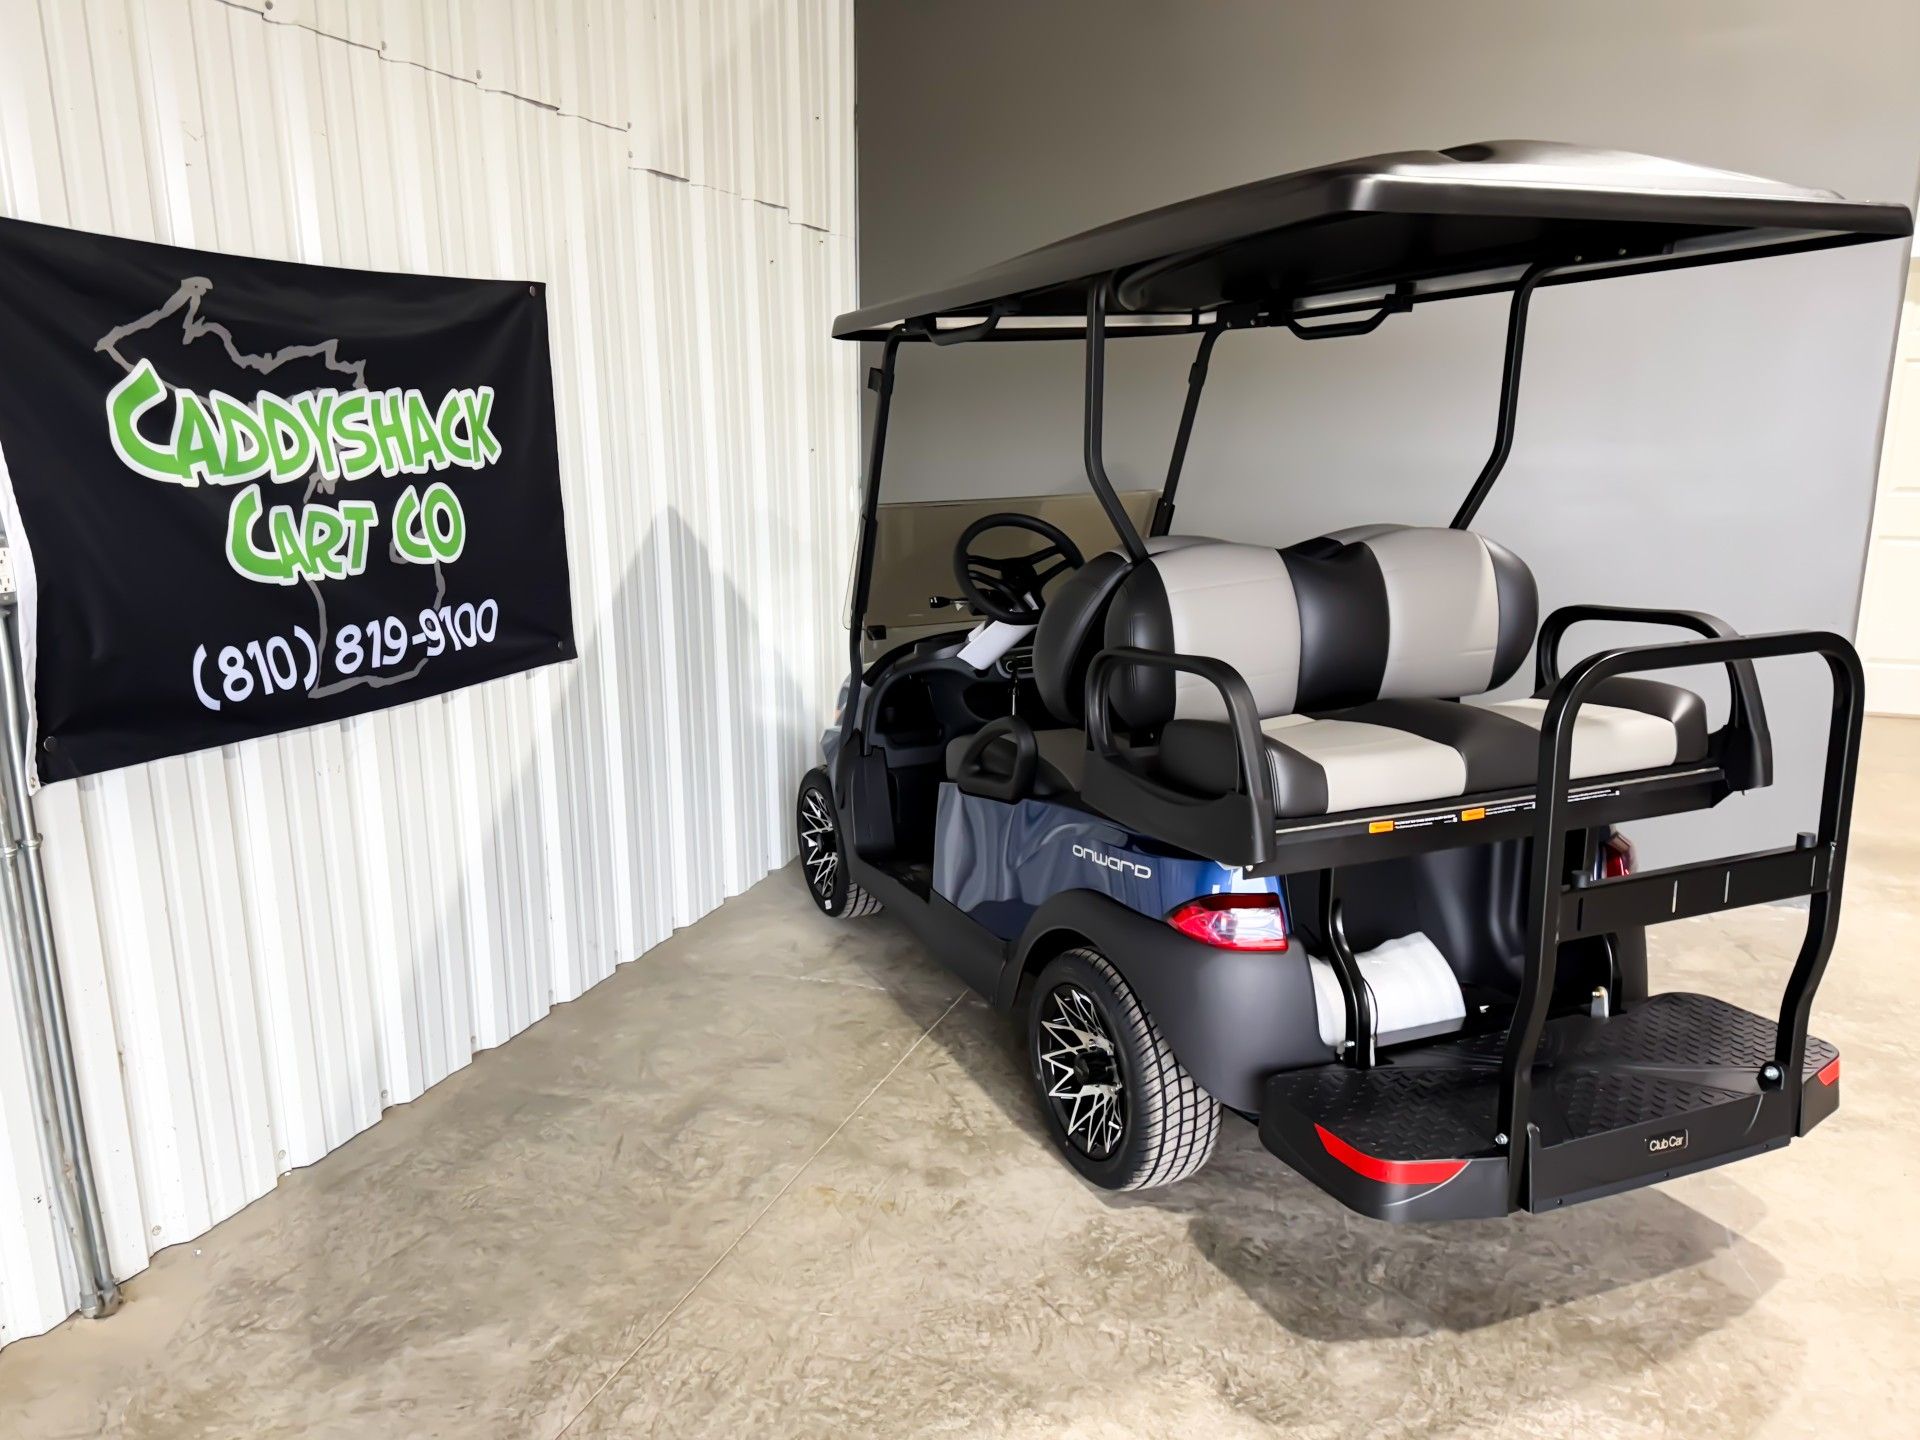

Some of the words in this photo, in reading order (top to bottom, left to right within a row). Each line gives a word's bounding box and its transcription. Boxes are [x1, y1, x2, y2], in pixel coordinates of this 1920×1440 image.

[106, 358, 501, 486] CADDYSHACK
[225, 484, 378, 586] CART
[392, 481, 466, 564] CO
[192, 624, 319, 711] (810)
[335, 598, 499, 675] 819-9100
[1649, 1138, 1669, 1152] Club
[1668, 1135, 1684, 1147] Car
